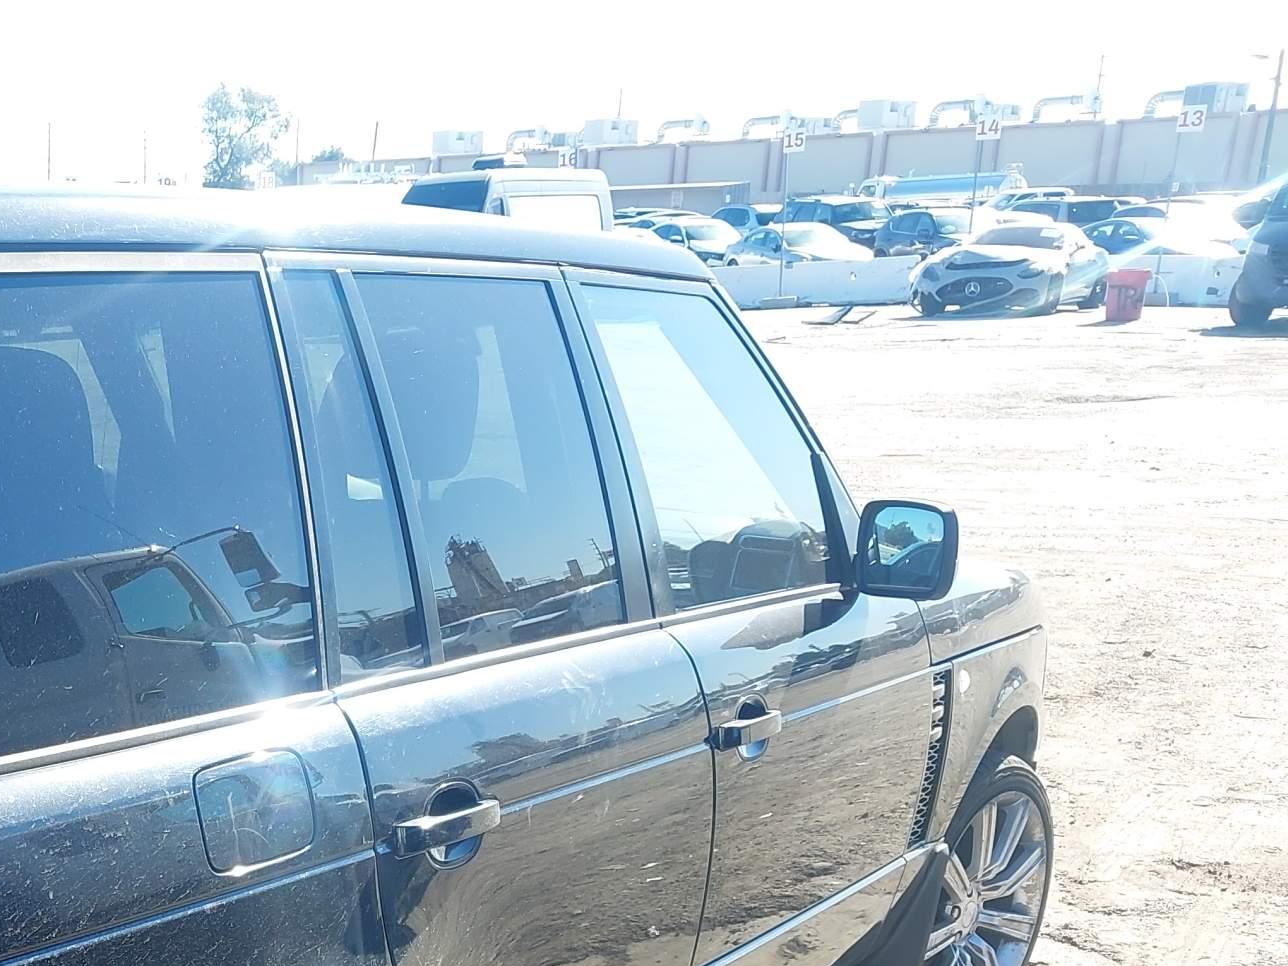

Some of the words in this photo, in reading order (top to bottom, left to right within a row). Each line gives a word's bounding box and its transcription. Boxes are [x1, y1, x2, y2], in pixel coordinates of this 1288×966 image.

[976, 118, 1001, 136] 14
[1177, 109, 1205, 128] 13
[784, 132, 804, 149] 15
